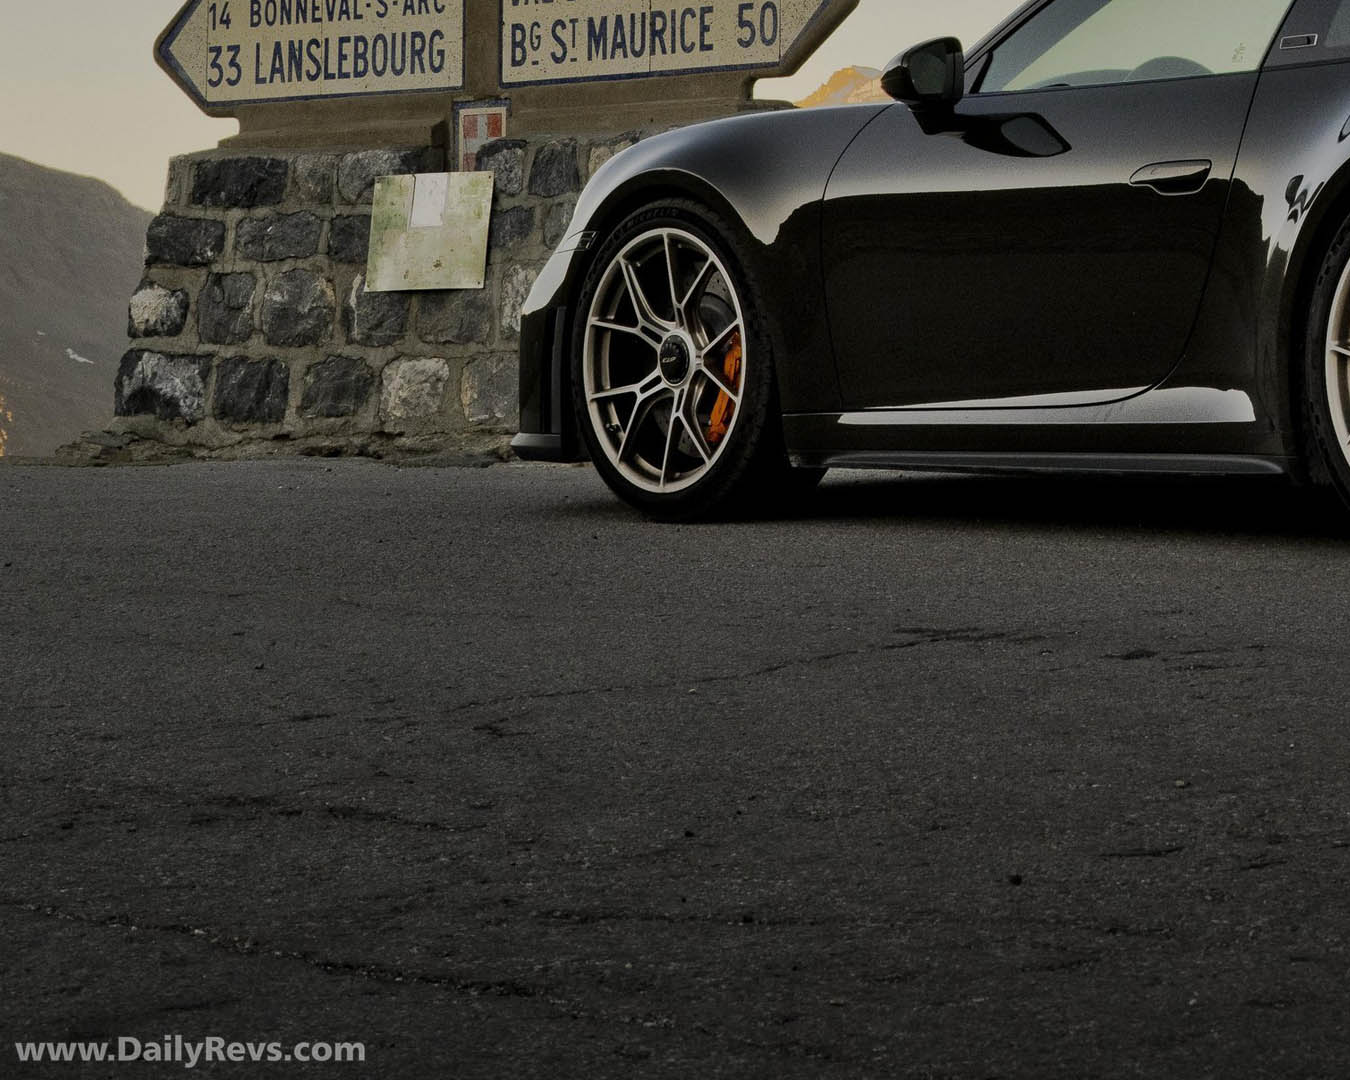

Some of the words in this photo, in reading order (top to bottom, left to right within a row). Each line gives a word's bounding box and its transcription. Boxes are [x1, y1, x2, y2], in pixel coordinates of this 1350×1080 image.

[208, 1, 231, 31] 14
[511, 21, 541, 67] BG
[550, 18, 579, 65] ST
[587, 5, 714, 62] MAURICE
[737, 0, 778, 48] 50
[207, 44, 242, 87] 33
[255, 29, 445, 85] LANSLEBOURG
